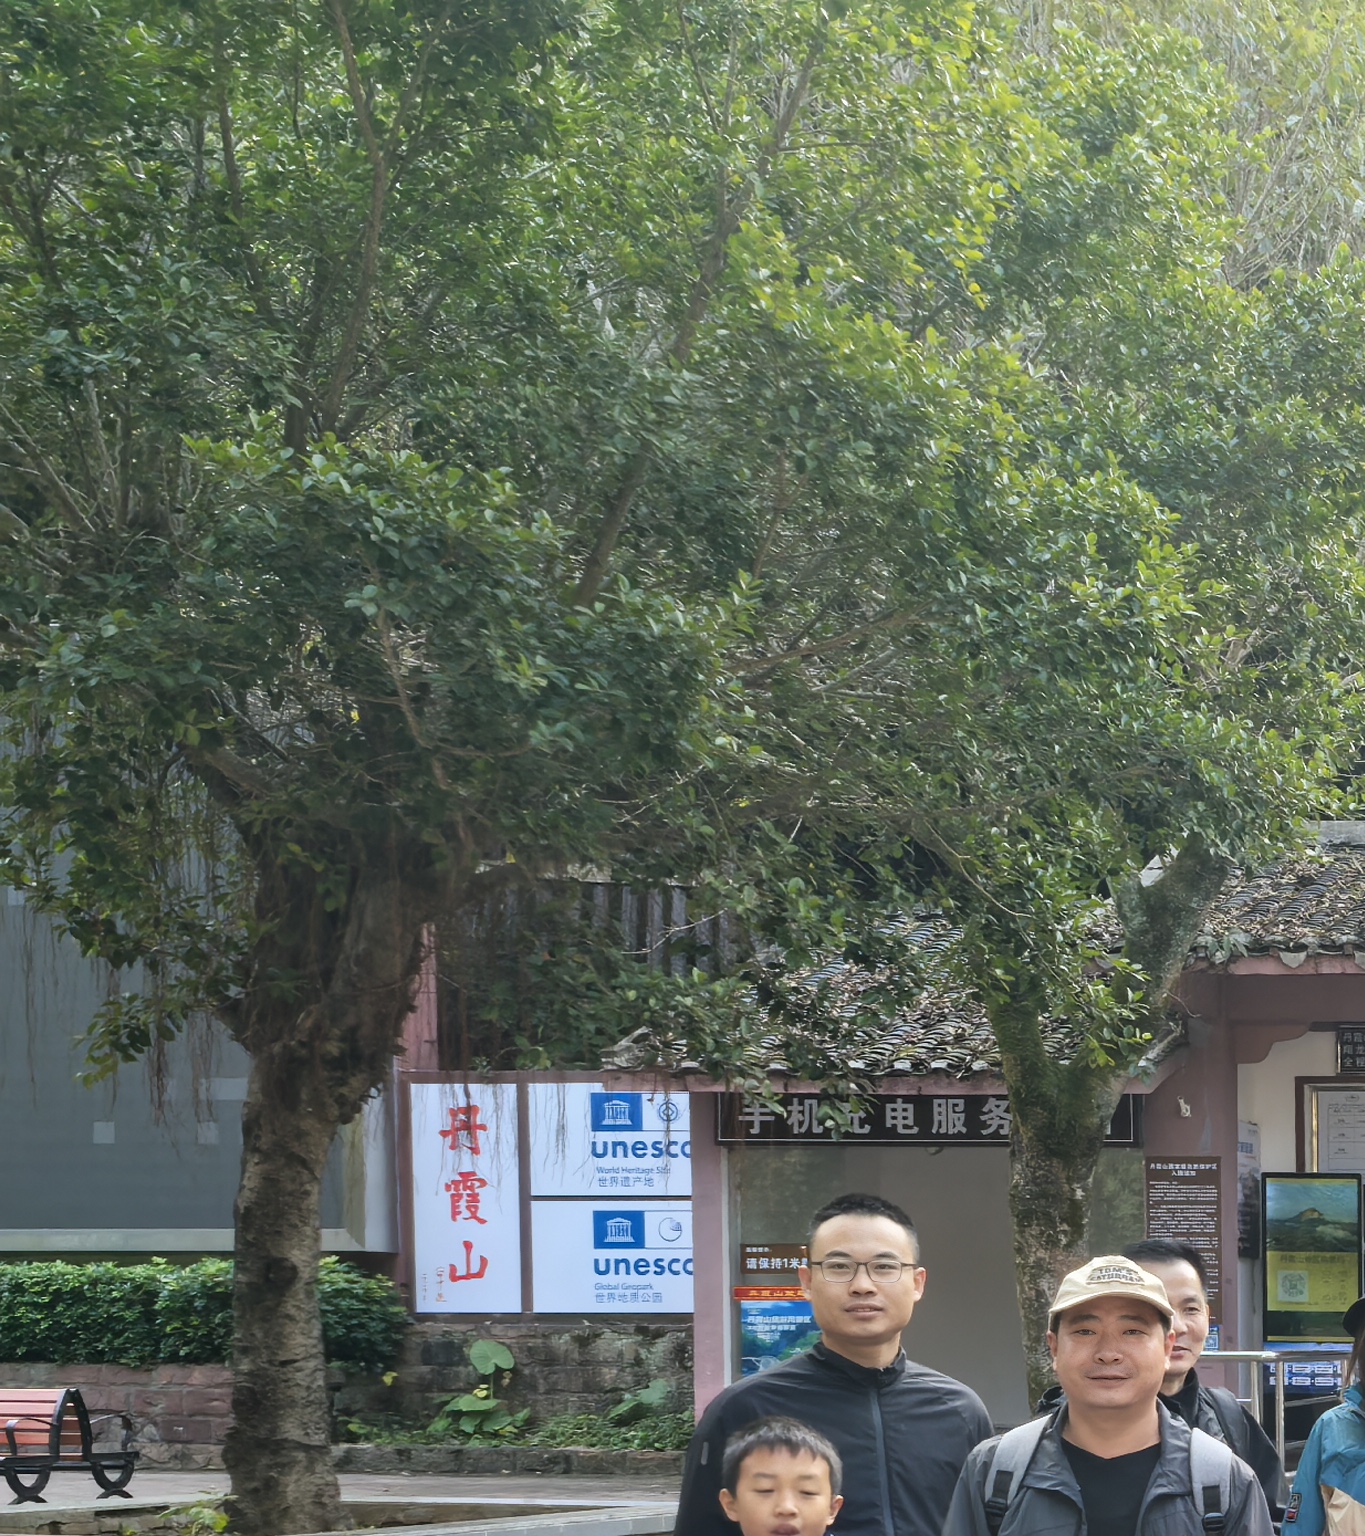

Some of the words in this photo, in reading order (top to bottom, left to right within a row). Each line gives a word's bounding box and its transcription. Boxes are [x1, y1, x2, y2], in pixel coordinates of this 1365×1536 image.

[596, 1166, 620, 1174] World
[598, 1176, 654, 1187] 世界遗产地
[438, 1104, 489, 1283] 丹霞山
[595, 1283, 620, 1291] Global
